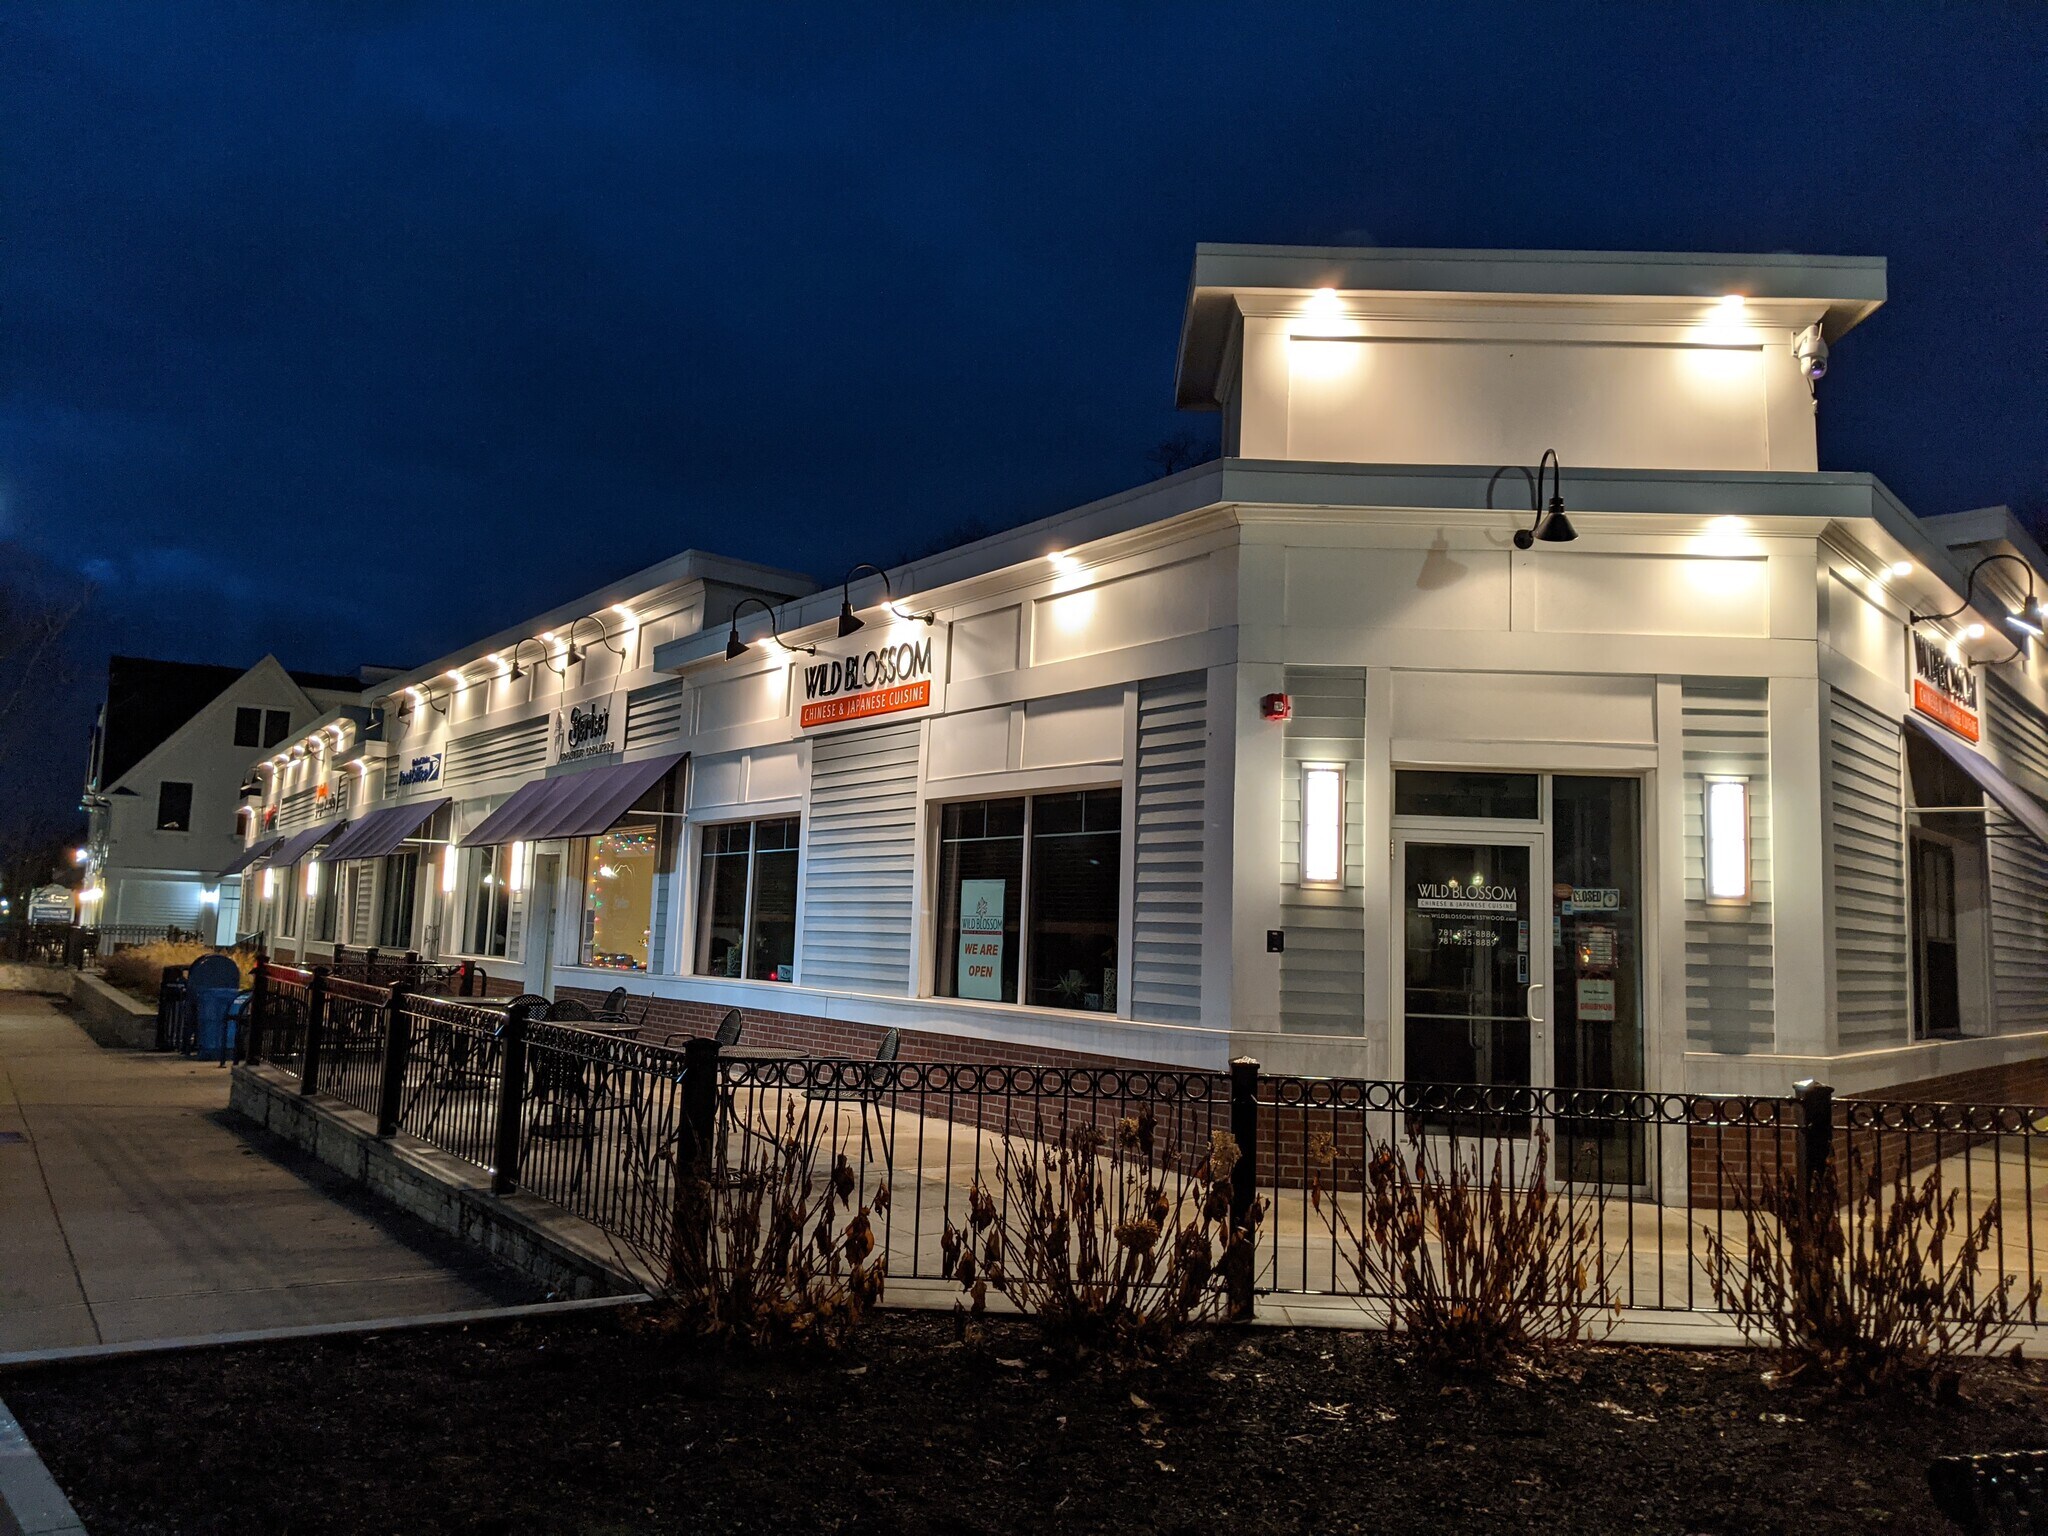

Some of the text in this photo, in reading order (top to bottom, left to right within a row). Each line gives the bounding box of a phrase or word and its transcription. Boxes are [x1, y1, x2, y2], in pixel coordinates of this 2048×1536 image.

[804, 637, 932, 699] WILD BLOSSOM
[804, 686, 924, 721] CHINESE & JAPANESE CUISINE
[1417, 883, 1517, 901] WILD BLOSSOM
[1573, 890, 1602, 902] CLOSED
[1456, 901, 1486, 909] JAPANESE
[1488, 902, 1514, 910] CUISINE
[962, 917, 1003, 931] WILD BLOSSOM
[965, 943, 999, 956] WE ARE
[968, 965, 993, 977] OPEN
